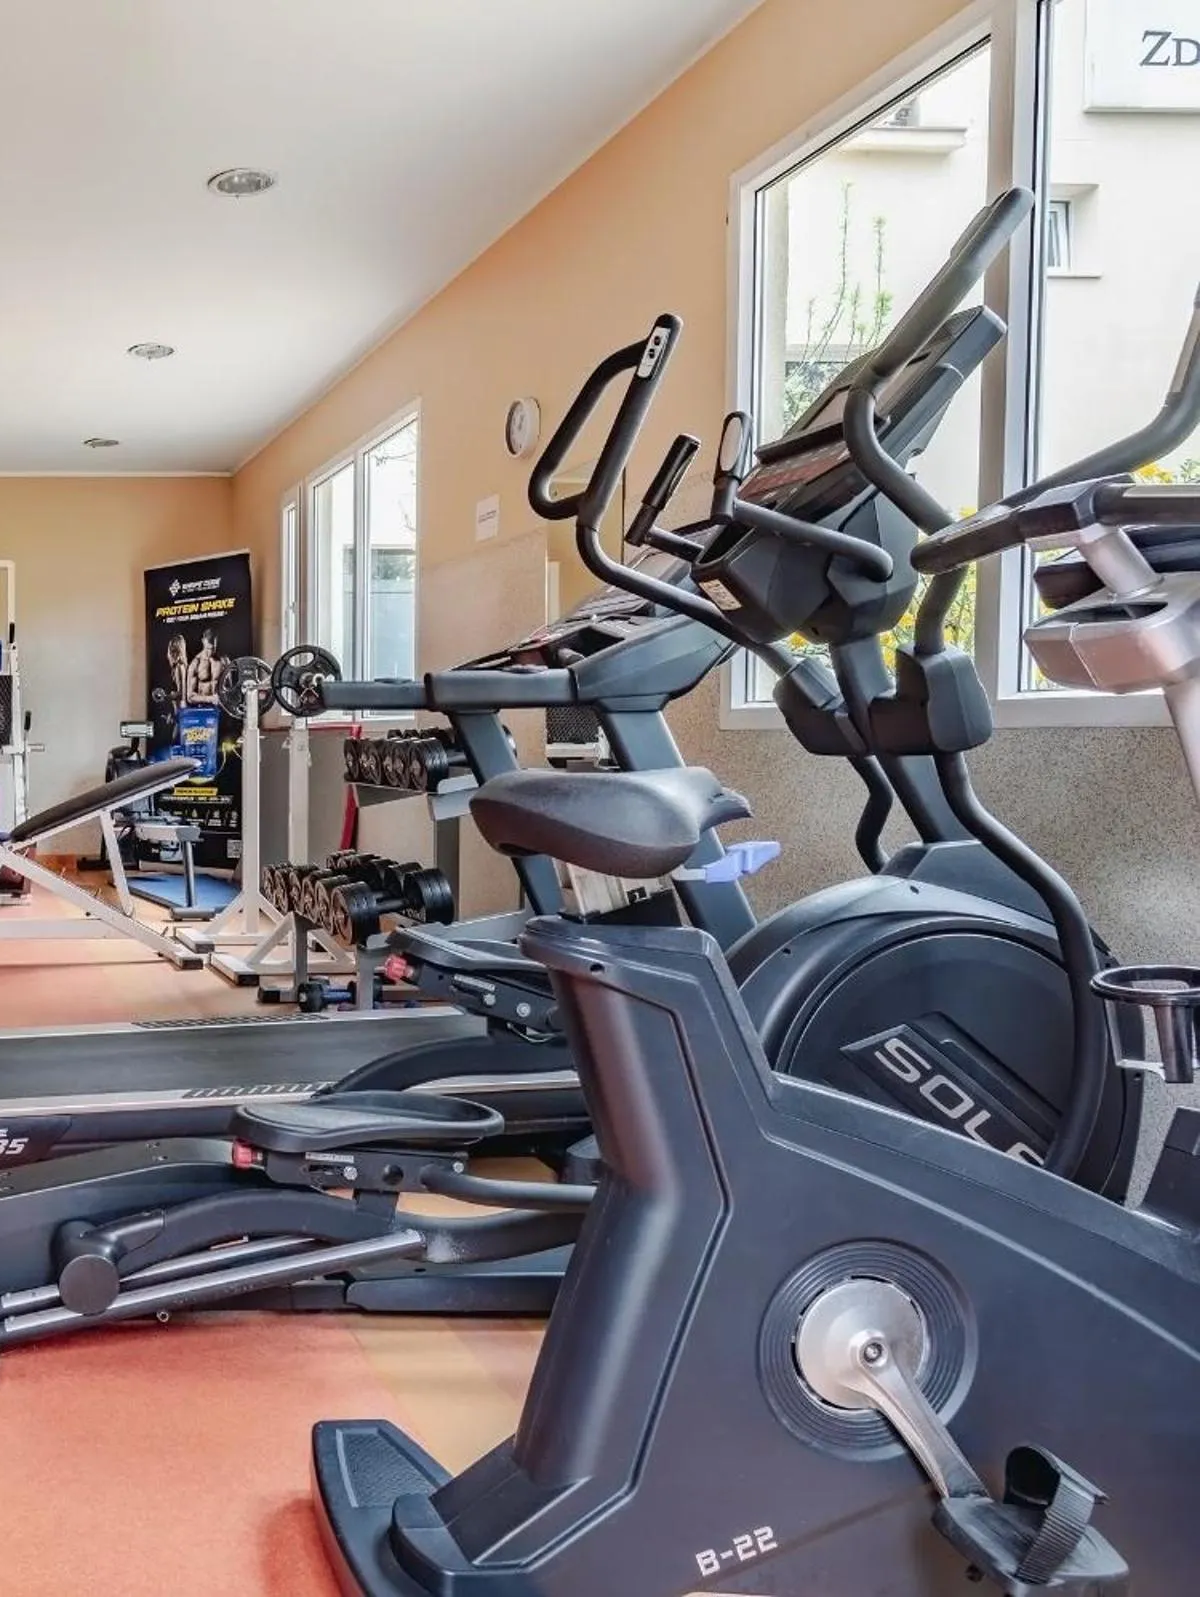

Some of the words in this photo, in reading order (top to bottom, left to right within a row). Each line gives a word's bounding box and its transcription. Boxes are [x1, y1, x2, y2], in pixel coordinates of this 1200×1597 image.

[1139, 30, 1200, 67] ZD
[156, 603, 199, 617] PROTEIN
[201, 598, 236, 612] SHAKE
[695, 1525, 779, 1577] B-22
